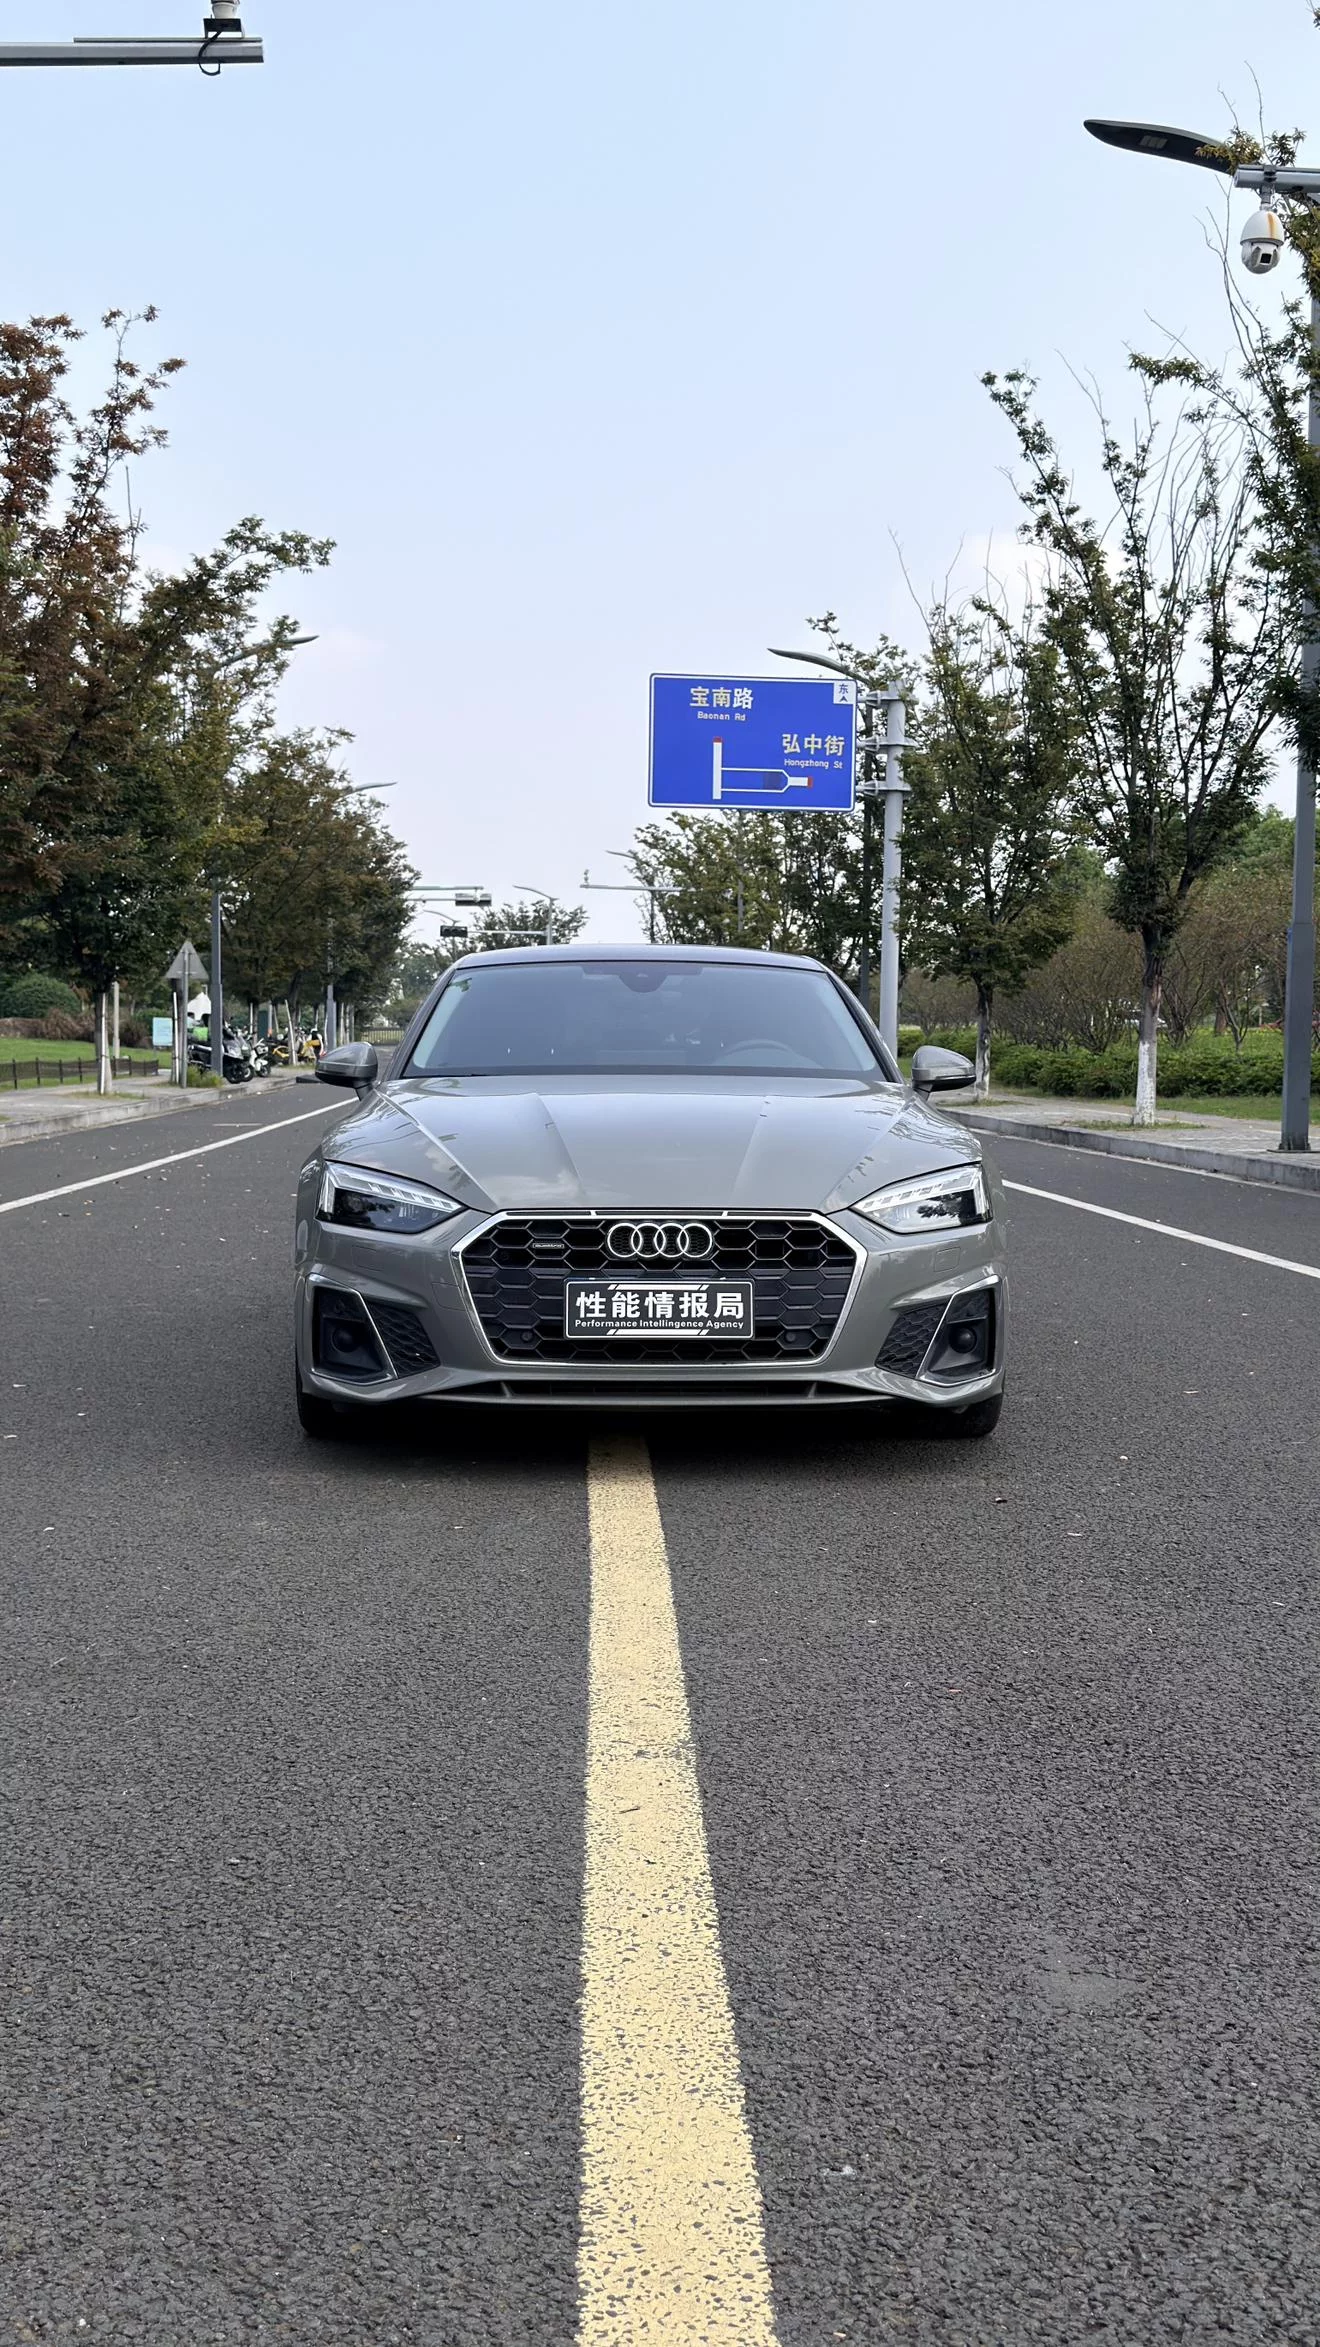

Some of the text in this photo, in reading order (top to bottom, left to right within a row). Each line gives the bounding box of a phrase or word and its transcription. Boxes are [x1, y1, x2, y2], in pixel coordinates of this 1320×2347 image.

[838, 683, 849, 694] 东
[690, 686, 753, 709] 宝南路
[697, 711, 746, 721] Baonan Rd
[782, 733, 845, 756] 弘中街
[833, 761, 843, 769] St
[575, 1291, 745, 1319] 性能情报局
[575, 1319, 744, 1329] Performance Intellingence Agency
